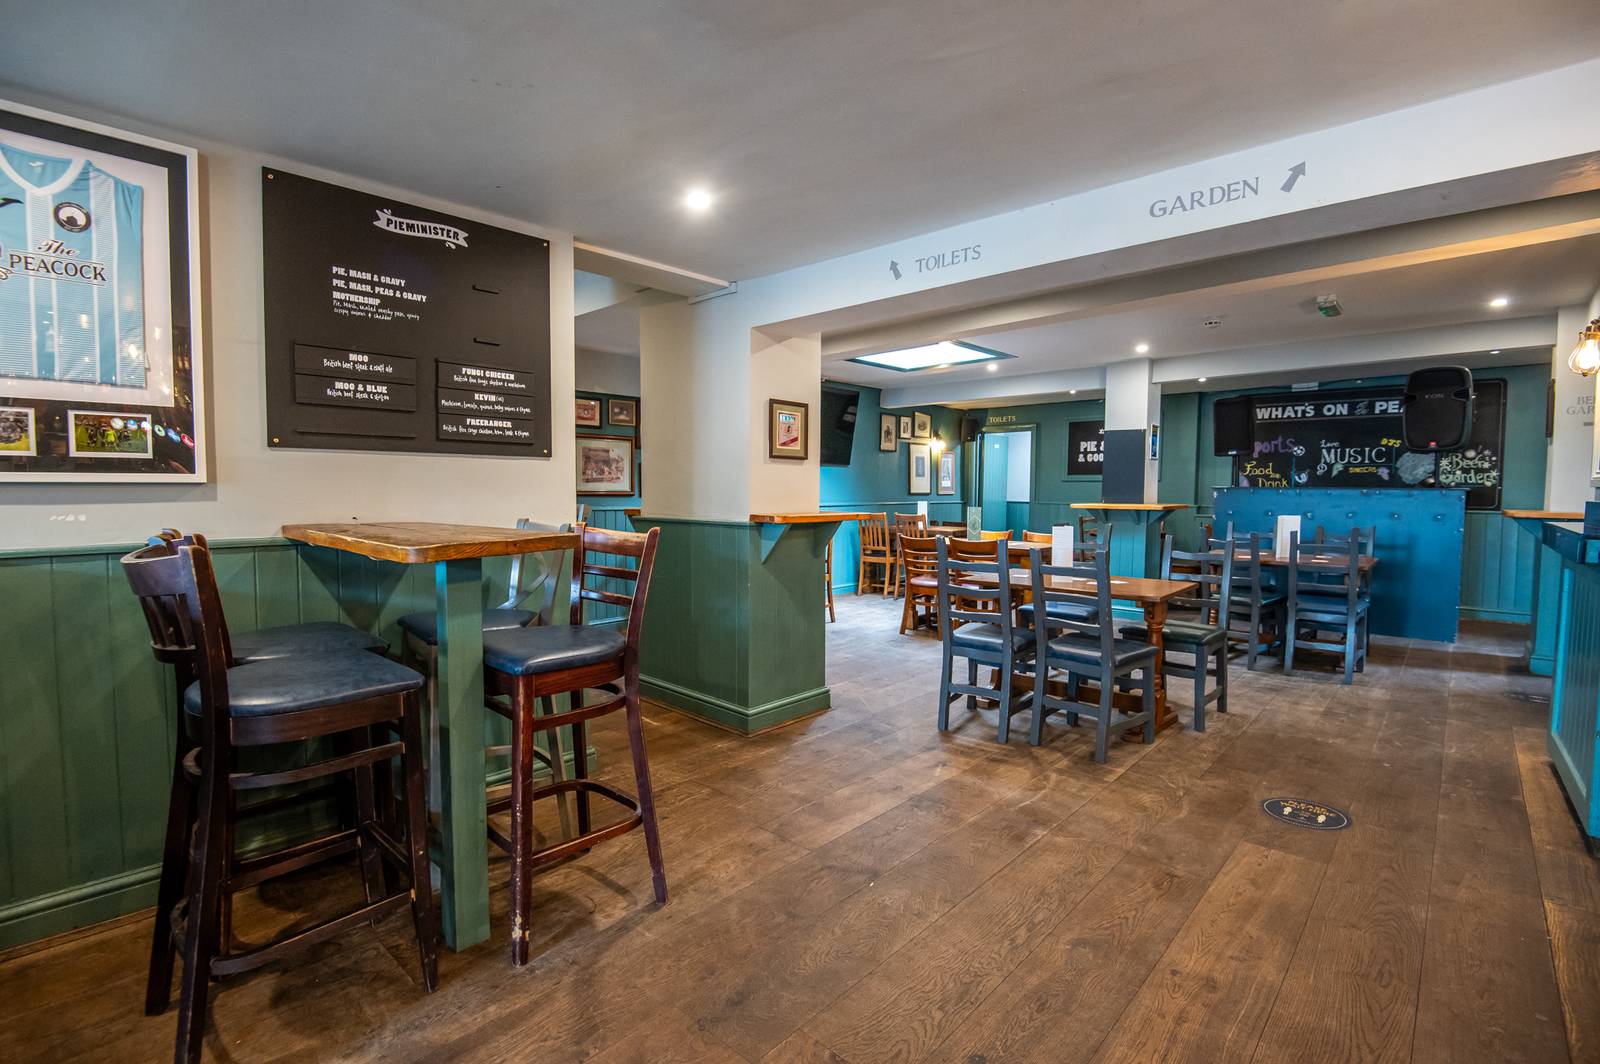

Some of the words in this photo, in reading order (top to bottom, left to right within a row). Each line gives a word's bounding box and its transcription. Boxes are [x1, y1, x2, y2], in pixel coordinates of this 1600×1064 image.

[1149, 176, 1260, 218] GARDEN
[385, 217, 460, 241] PIEMINISTER
[37, 239, 76, 257] The
[915, 244, 982, 274] TOILETS
[9, 253, 107, 282] PEACOCK
[332, 266, 348, 276] PIE,
[349, 269, 372, 281] MASH
[380, 276, 406, 287] GRAVY
[332, 278, 347, 289] PIE,
[349, 282, 373, 294] MASH,
[374, 286, 394, 296] PEAS
[402, 292, 427, 302] GRAVY
[332, 291, 380, 306] MOTHERSHIP
[348, 353, 369, 362] MOO
[462, 367, 484, 377] FUNGI
[485, 370, 516, 380] CHICKEN
[335, 382, 355, 390] MOO
[358, 384, 364, 392] &
[366, 384, 388, 394] BLUE
[474, 393, 496, 402] KEVIN
[1255, 402, 1316, 419] WHAT'S
[1322, 403, 1348, 416] ON
[1374, 400, 1404, 414] PE
[466, 418, 513, 428] FREERANGER
[989, 416, 1016, 424] TOILETS
[1080, 441, 1098, 452] PIE
[1078, 454, 1086, 462] &
[1321, 448, 1386, 465] MUSIC
[1243, 460, 1272, 476] Food
